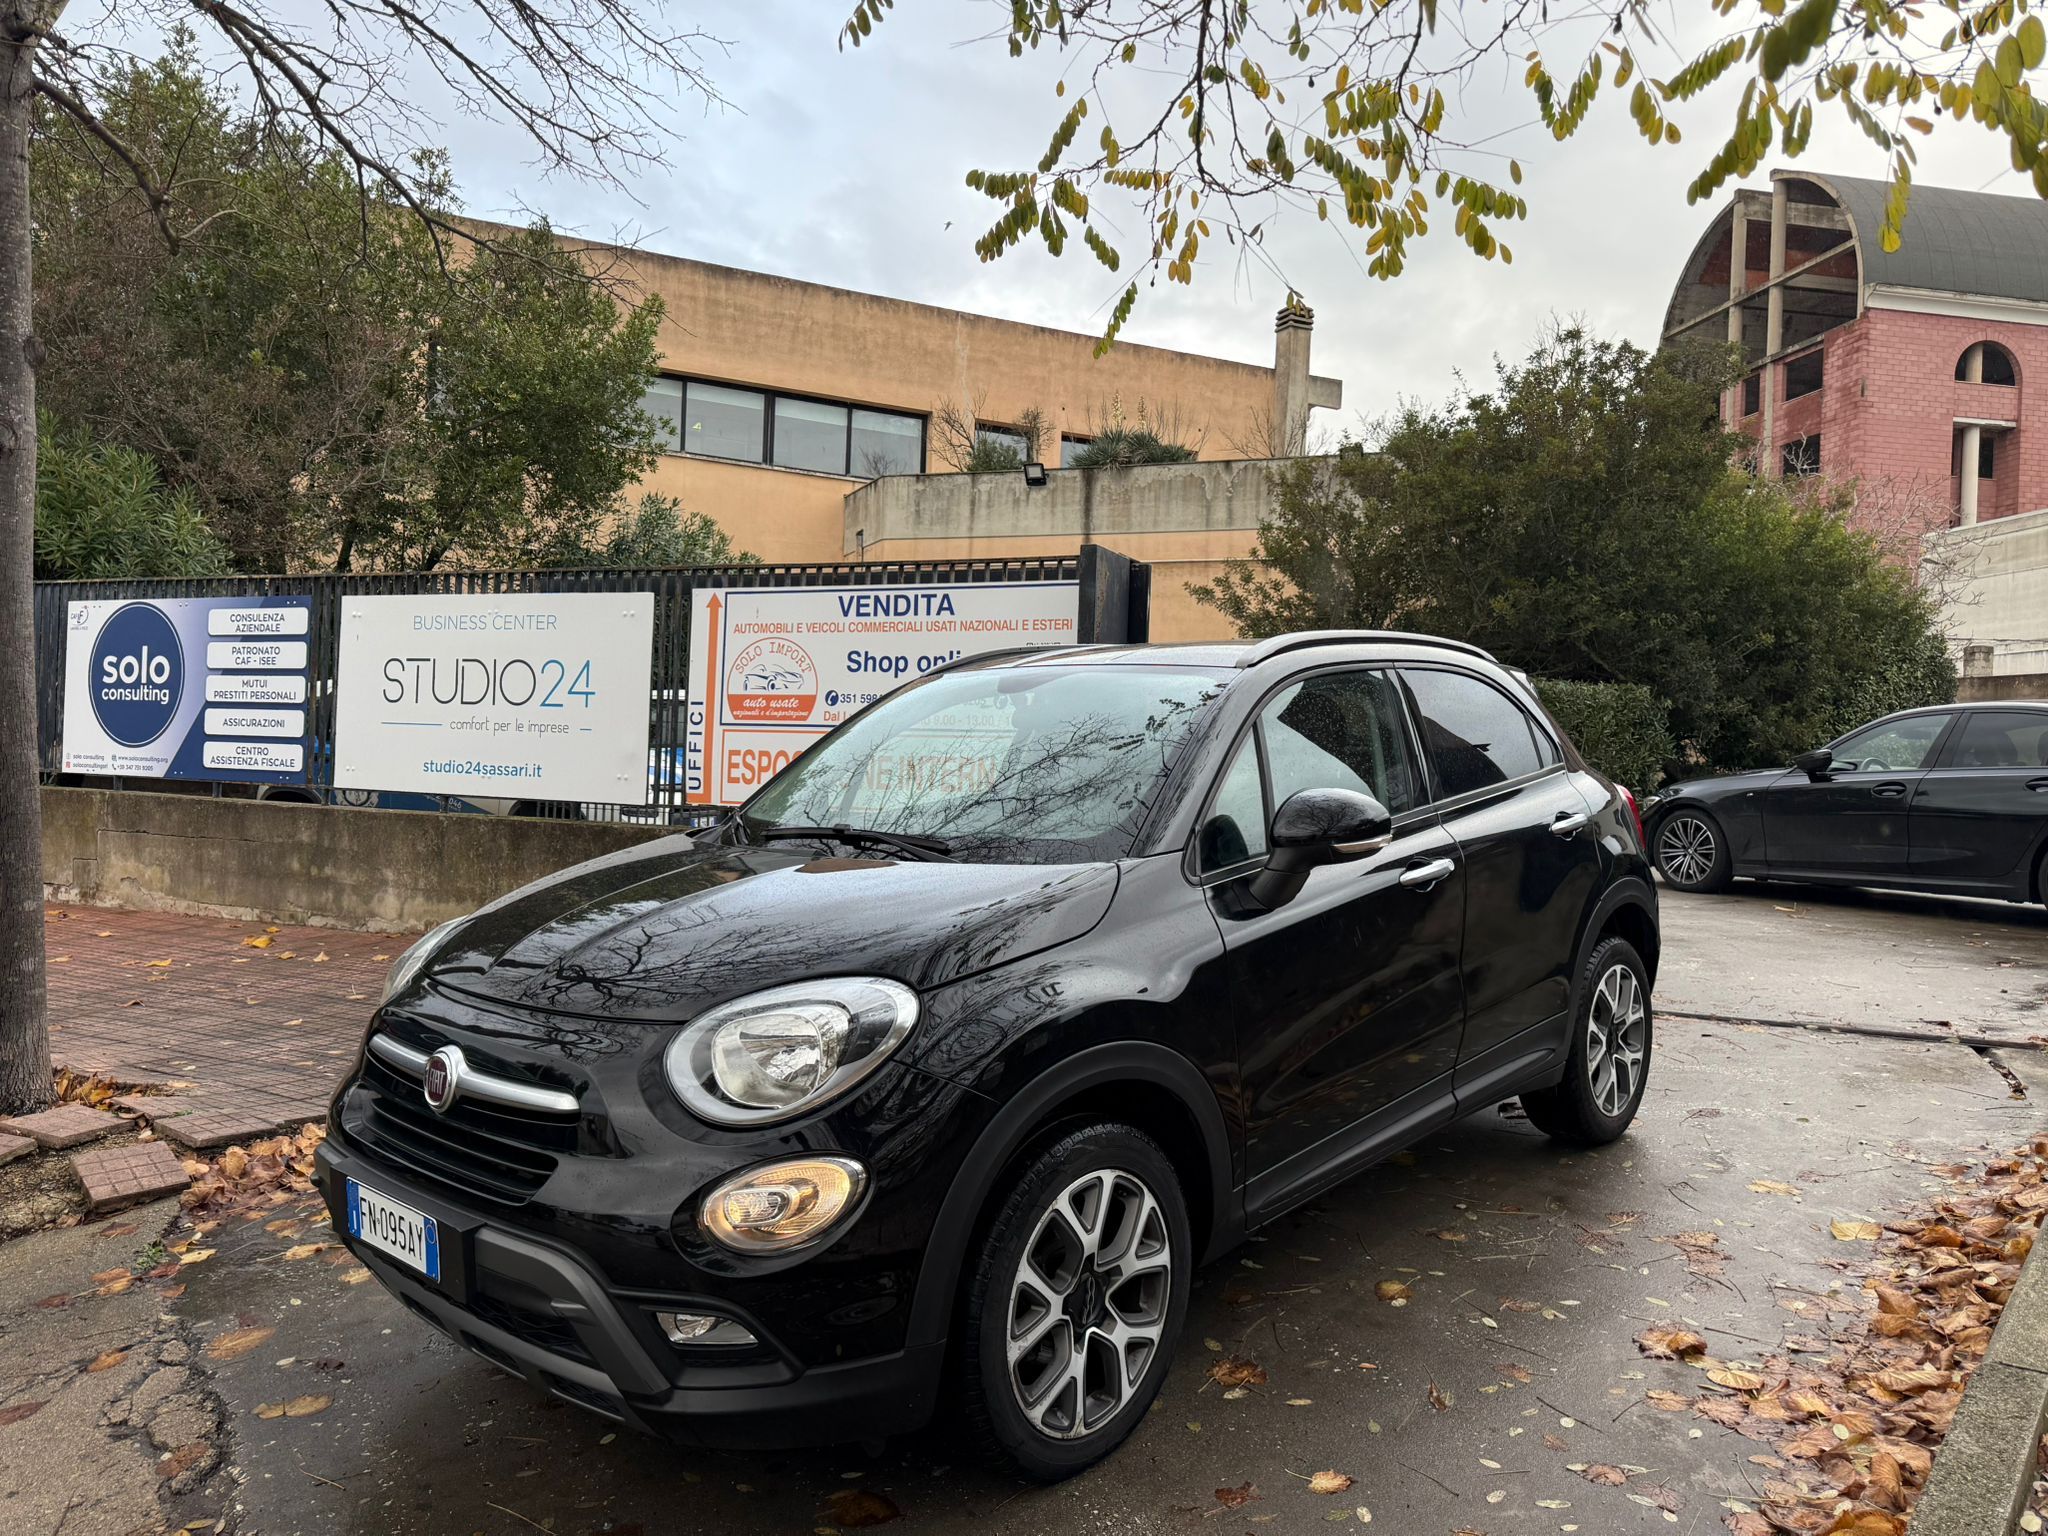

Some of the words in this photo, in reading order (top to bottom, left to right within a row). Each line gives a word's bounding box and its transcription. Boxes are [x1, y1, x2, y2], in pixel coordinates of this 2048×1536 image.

[838, 593, 955, 617] VENDITA
[229, 613, 286, 623] CONSULENZA
[413, 614, 487, 631] BUSINESS
[491, 613, 558, 631] CENTER
[733, 622, 794, 634] AUTOMOBILI
[797, 623, 804, 633] E
[806, 622, 846, 633] VEICOLI
[848, 620, 923, 633] COMMERCIALI
[926, 620, 957, 632] USATI
[960, 619, 1019, 632] NAZIONALI
[1022, 619, 1029, 631] E
[1032, 618, 1073, 631] ESTERI
[235, 623, 281, 633] AZIENDALE
[231, 646, 281, 656] PATRONATO
[735, 645, 762, 674] SOLO
[769, 641, 812, 673] IMPORT
[102, 645, 170, 684] solo
[234, 656, 252, 666] CAF
[258, 656, 277, 666] ISEE
[846, 650, 909, 679] Shop
[241, 679, 268, 689] MUTUI
[382, 657, 597, 709] STUDIO24
[101, 684, 170, 705] consulting
[213, 690, 248, 700] PRESTITI
[249, 690, 297, 701] PERSONALI
[743, 697, 767, 708] auto
[769, 697, 799, 708] usate
[840, 693, 857, 704] 351
[222, 717, 286, 728] ASSICURAZIONI
[823, 710, 840, 722] Dal
[449, 715, 490, 731] comfort
[493, 721, 512, 737] per
[515, 717, 525, 732] le
[528, 719, 570, 738] imprese
[235, 746, 270, 756] CENTRO
[688, 701, 704, 791] UFFICI
[210, 755, 259, 767] ASSISTENZA
[260, 757, 296, 768] FISCALE
[422, 759, 544, 778] studio24sassari.it
[727, 749, 803, 785] ESPO
[429, 1068, 446, 1095] FIAT
